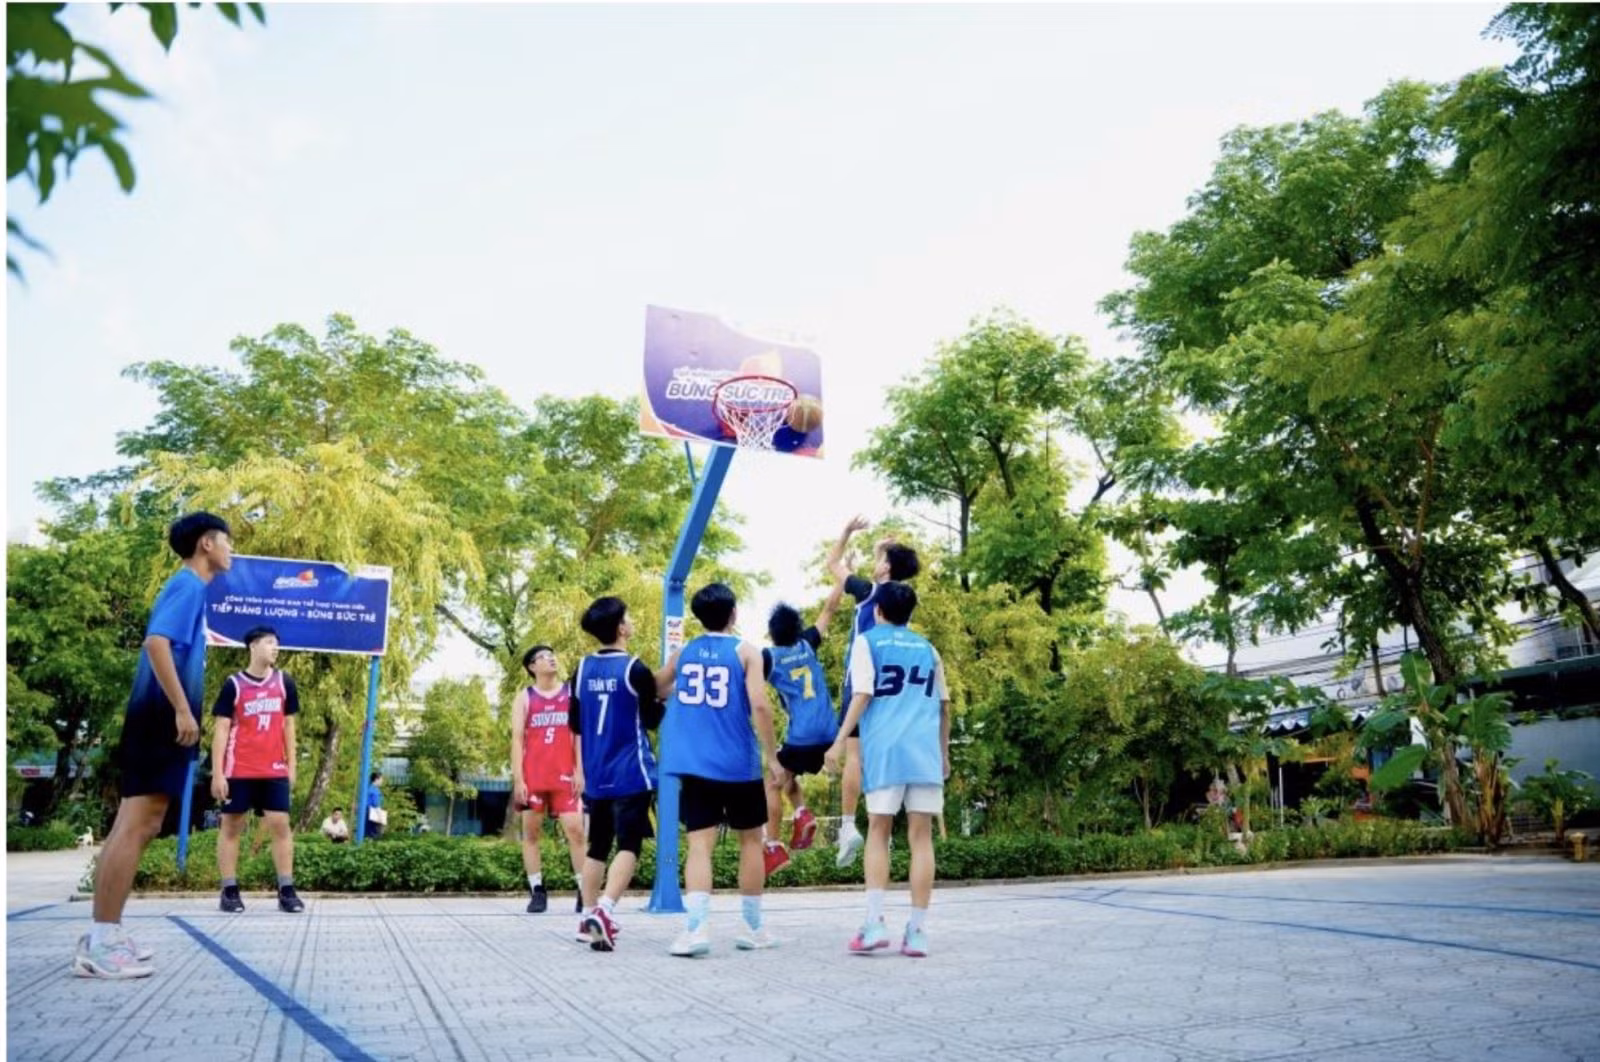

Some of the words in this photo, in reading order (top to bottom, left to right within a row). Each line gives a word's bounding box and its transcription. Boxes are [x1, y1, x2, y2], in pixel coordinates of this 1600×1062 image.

[211, 602, 232, 613] TIẾP
[678, 663, 729, 708] 33
[789, 665, 816, 699] 7
[874, 664, 935, 698] 34
[597, 694, 609, 735] 7
